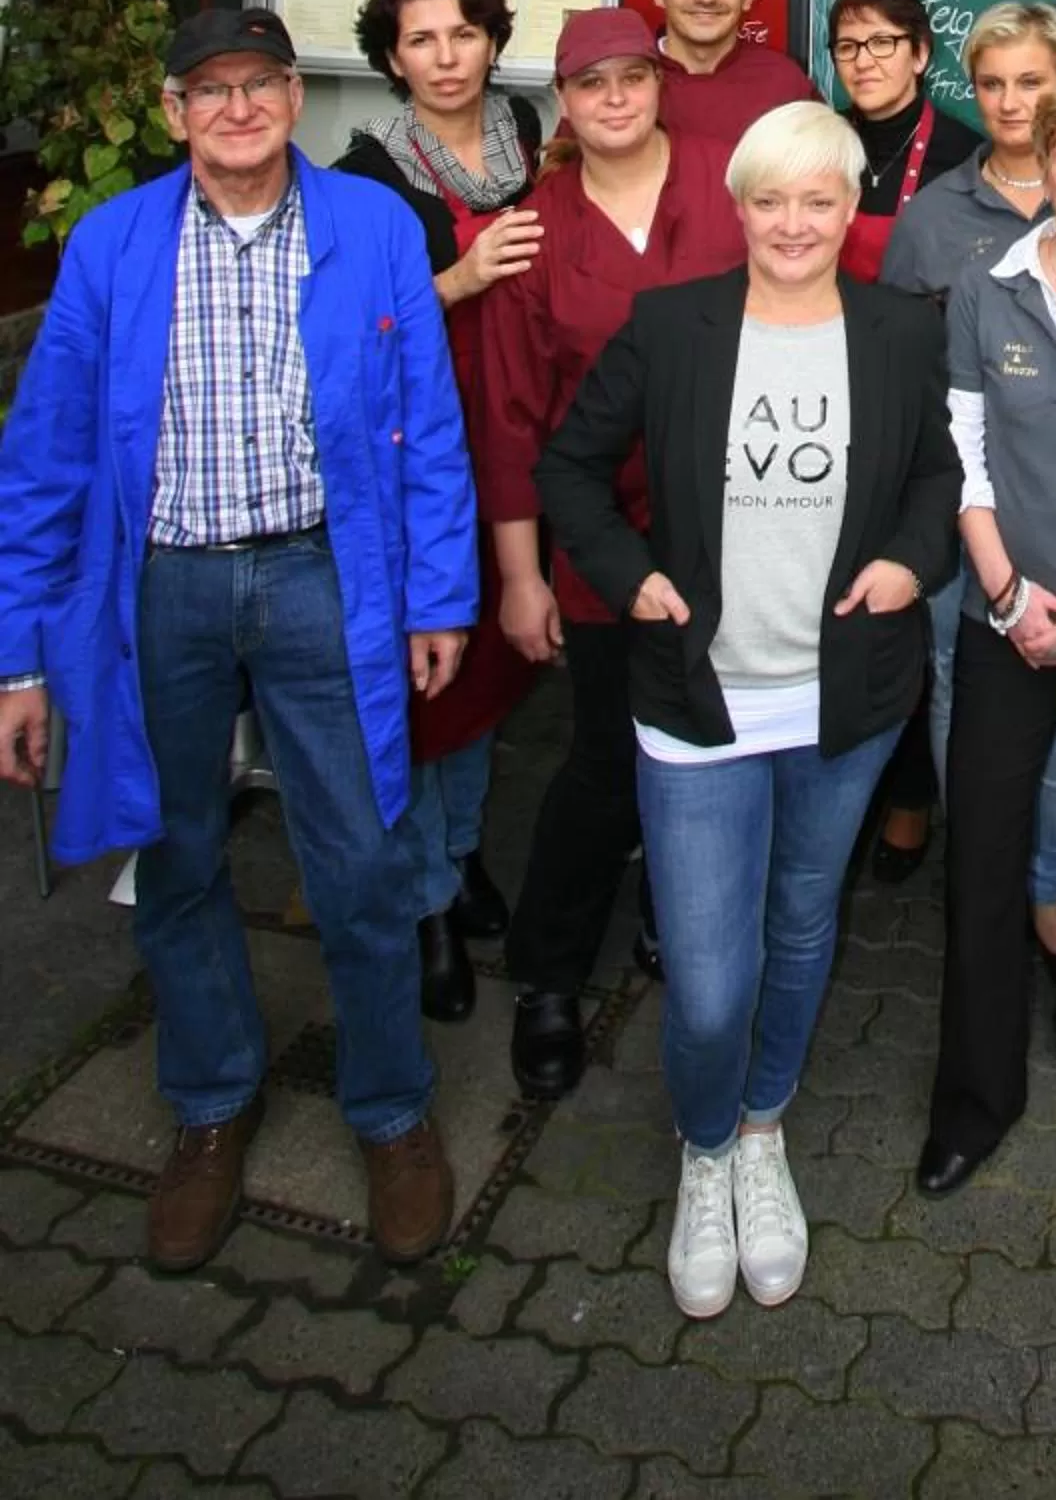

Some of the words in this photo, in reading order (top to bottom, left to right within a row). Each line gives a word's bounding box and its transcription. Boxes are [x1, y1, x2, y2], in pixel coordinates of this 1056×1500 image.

[743, 393, 829, 434] AU
[727, 495, 768, 509] MON
[772, 495, 834, 510] AMOUR
